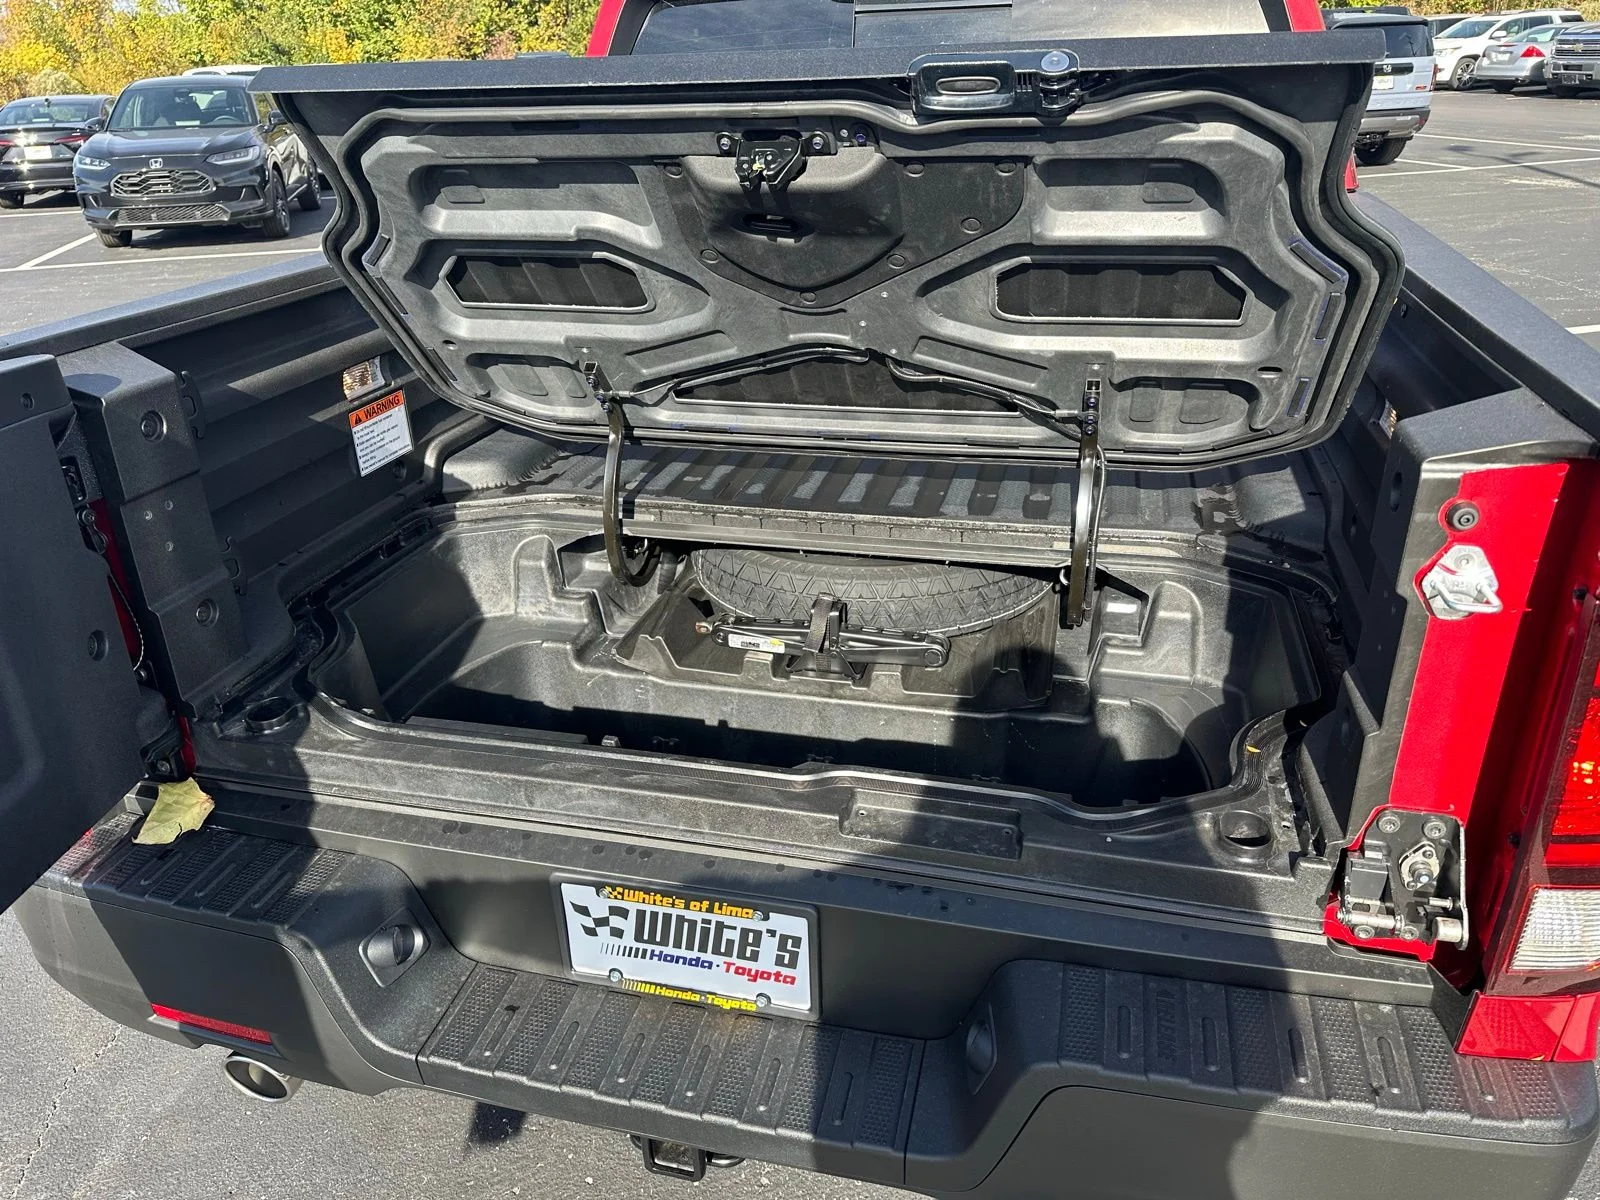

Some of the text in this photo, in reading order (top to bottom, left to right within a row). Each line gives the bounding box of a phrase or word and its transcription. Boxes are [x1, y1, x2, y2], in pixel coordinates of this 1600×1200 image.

[363, 395, 400, 419] WARNING
[623, 889, 755, 919] White's of Lima
[634, 908, 802, 969] White's
[649, 949, 796, 985] Honda Toyota
[656, 985, 757, 1012] Honda Toyota
